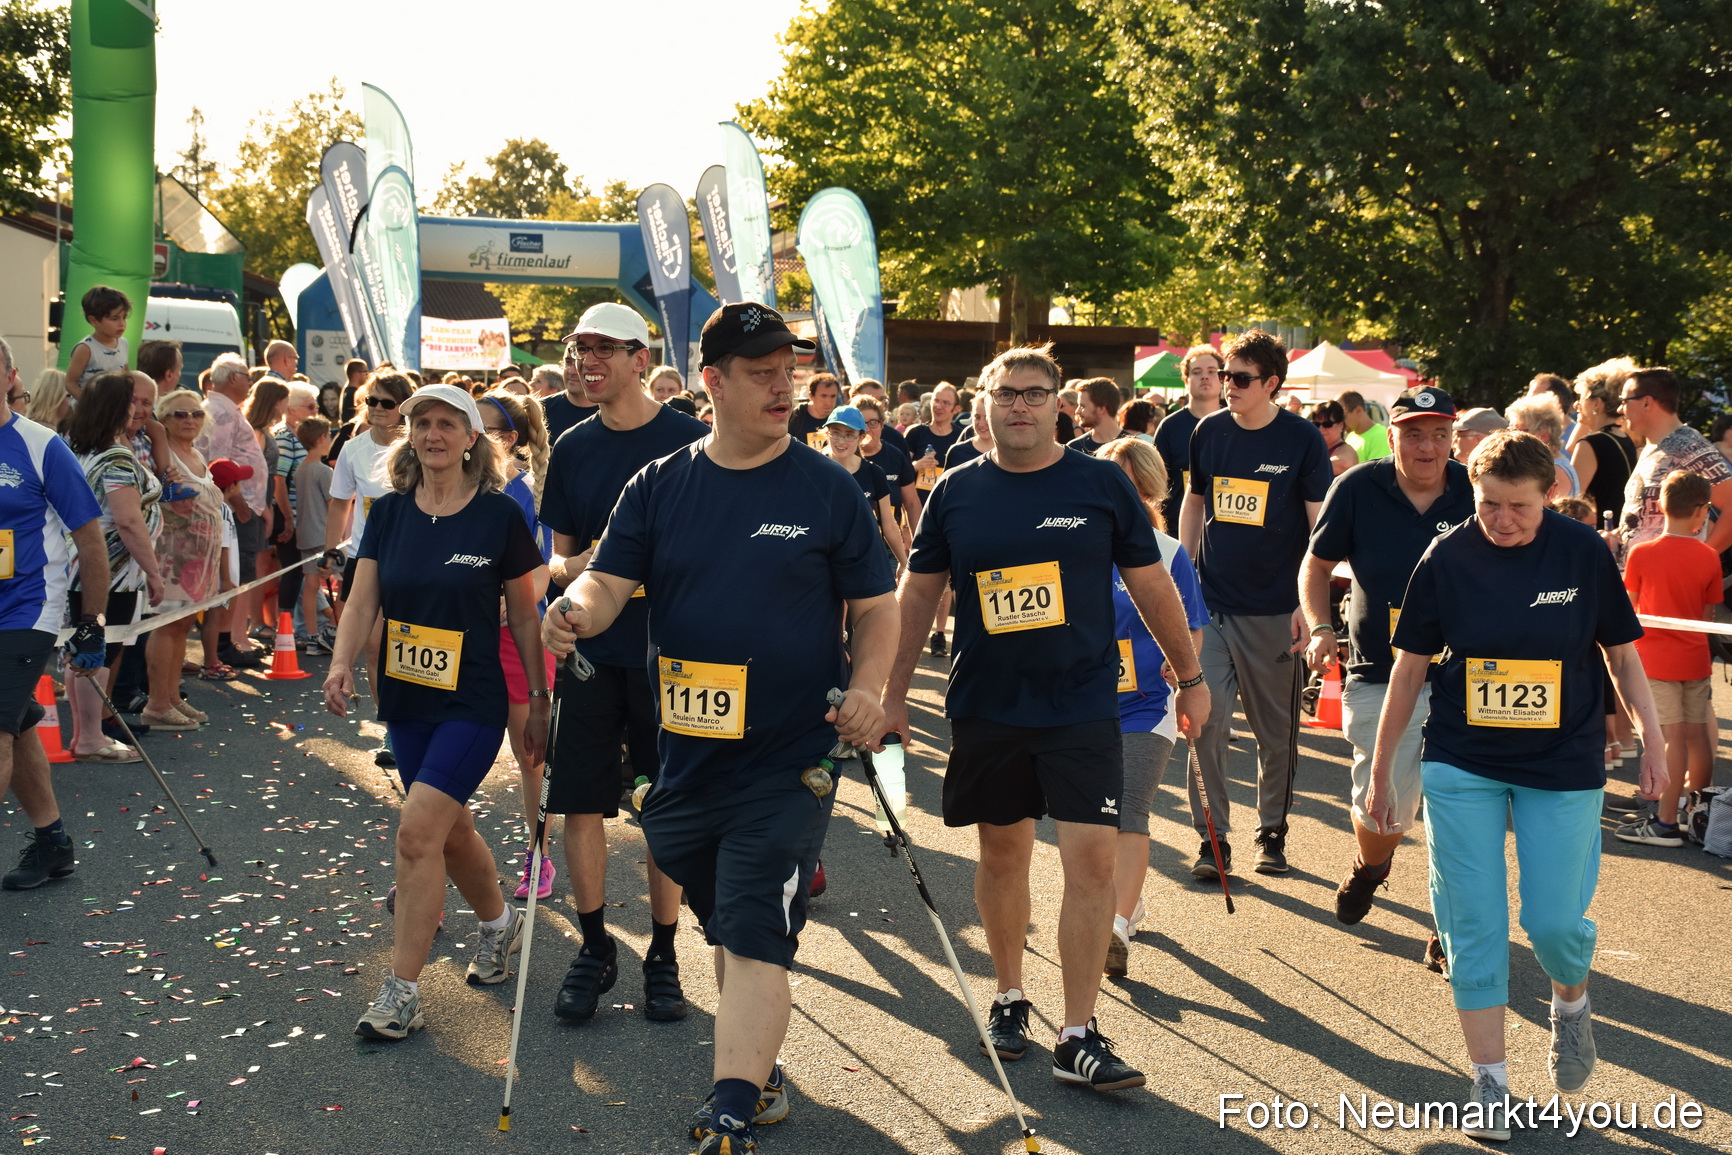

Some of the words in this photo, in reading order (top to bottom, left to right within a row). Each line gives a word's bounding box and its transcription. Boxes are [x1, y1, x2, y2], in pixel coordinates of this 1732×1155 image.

[516, 237, 541, 247] Fischer
[497, 252, 572, 269] firmenlauf
[1217, 492, 1257, 512] 1108
[989, 586, 1051, 615] 1120
[997, 613, 1020, 621] Rustler
[1021, 610, 1046, 619] Sascha
[395, 642, 448, 672] 1103
[400, 664, 425, 674] Wittmann
[426, 668, 439, 677] Gabi
[667, 685, 731, 717] 1119
[1477, 684, 1548, 709] 1123
[673, 713, 695, 722] Reulein
[696, 716, 720, 725] Marco
[1477, 707, 1512, 716] Wittmann
[1513, 708, 1547, 716] Elisabeth
[1101, 806, 1118, 816] erima
